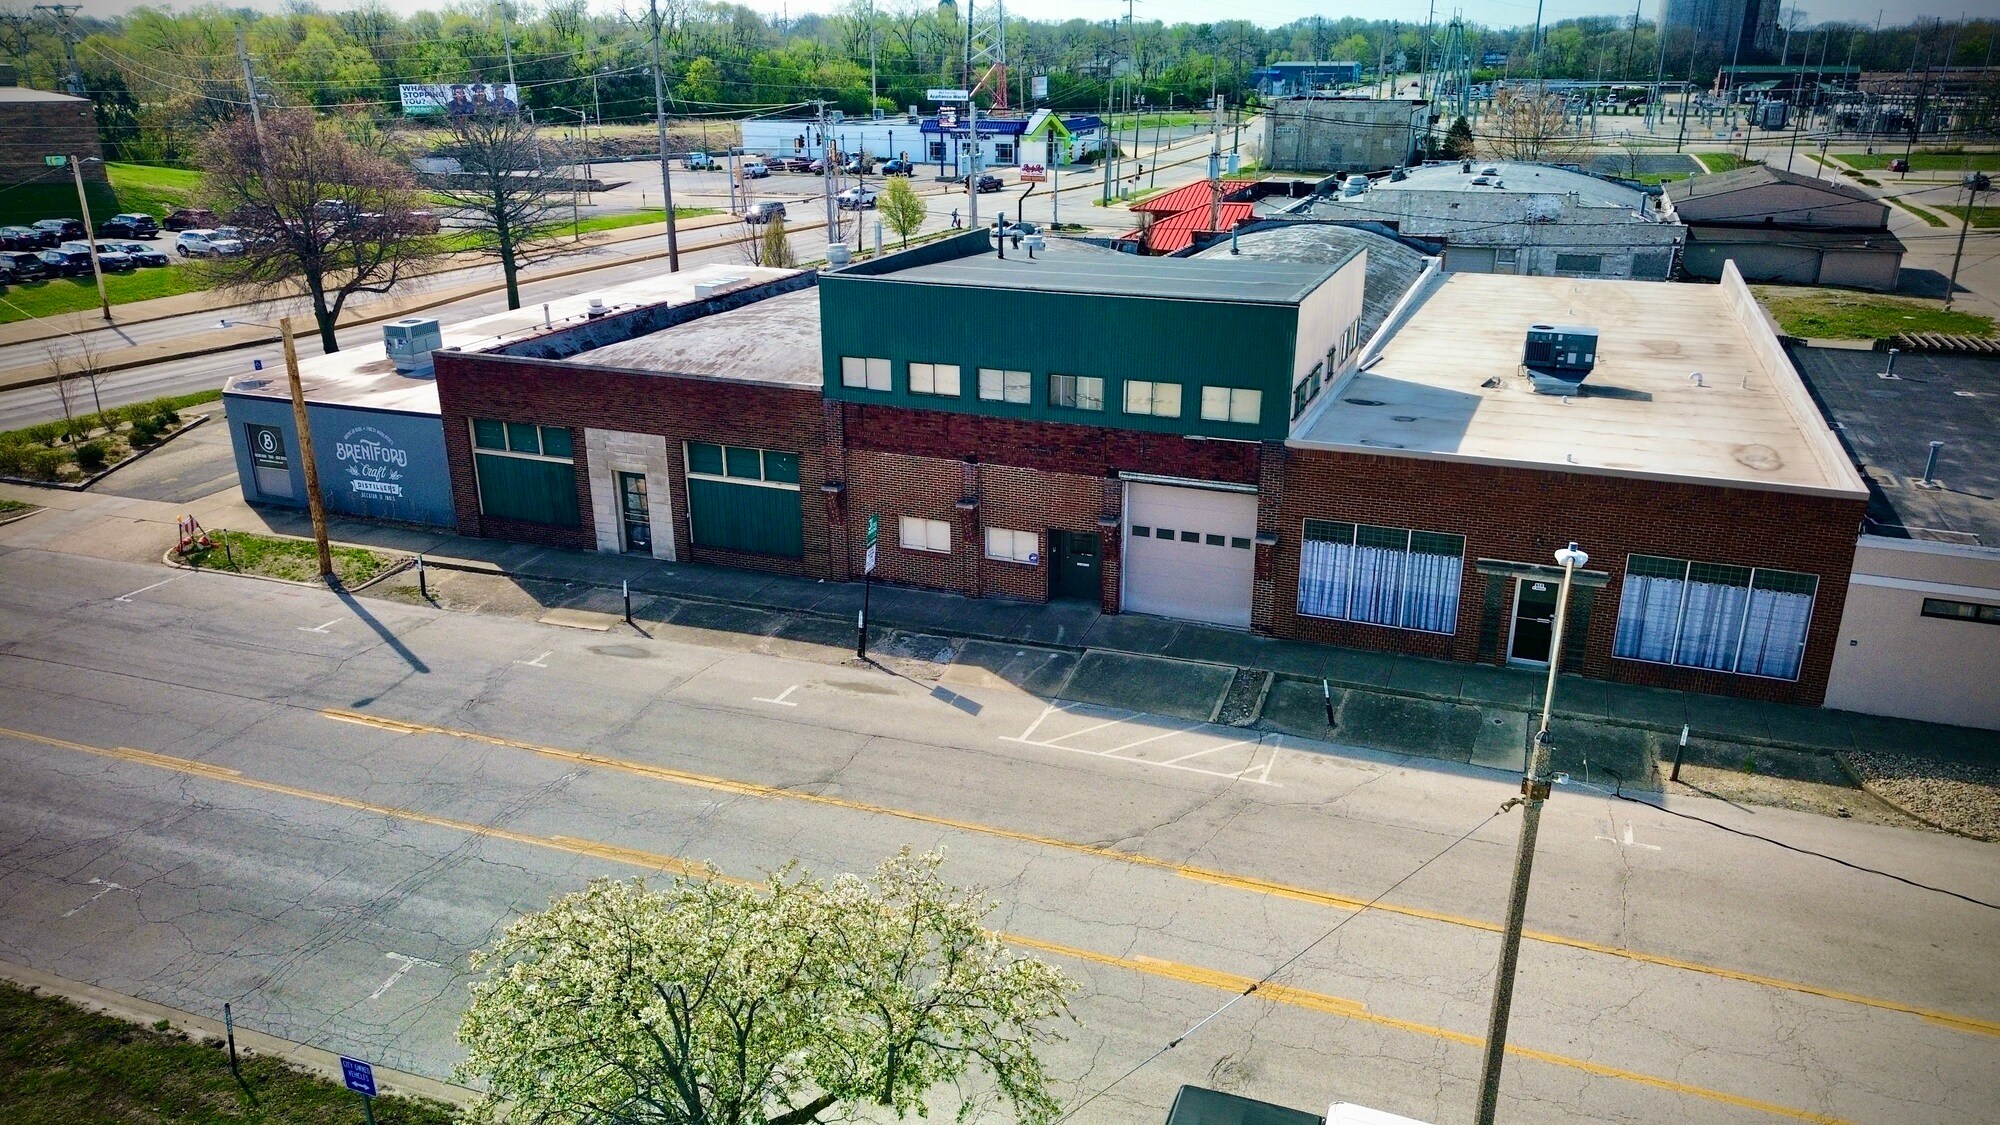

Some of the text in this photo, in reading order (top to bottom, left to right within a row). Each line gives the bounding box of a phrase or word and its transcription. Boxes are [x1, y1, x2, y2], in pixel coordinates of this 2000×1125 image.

[263, 434, 273, 450] B
[336, 439, 407, 467] BRENTFORD
[361, 462, 387, 481] Craft
[357, 482, 397, 493] DISTILLERS
[342, 1060, 353, 1069] CITY
